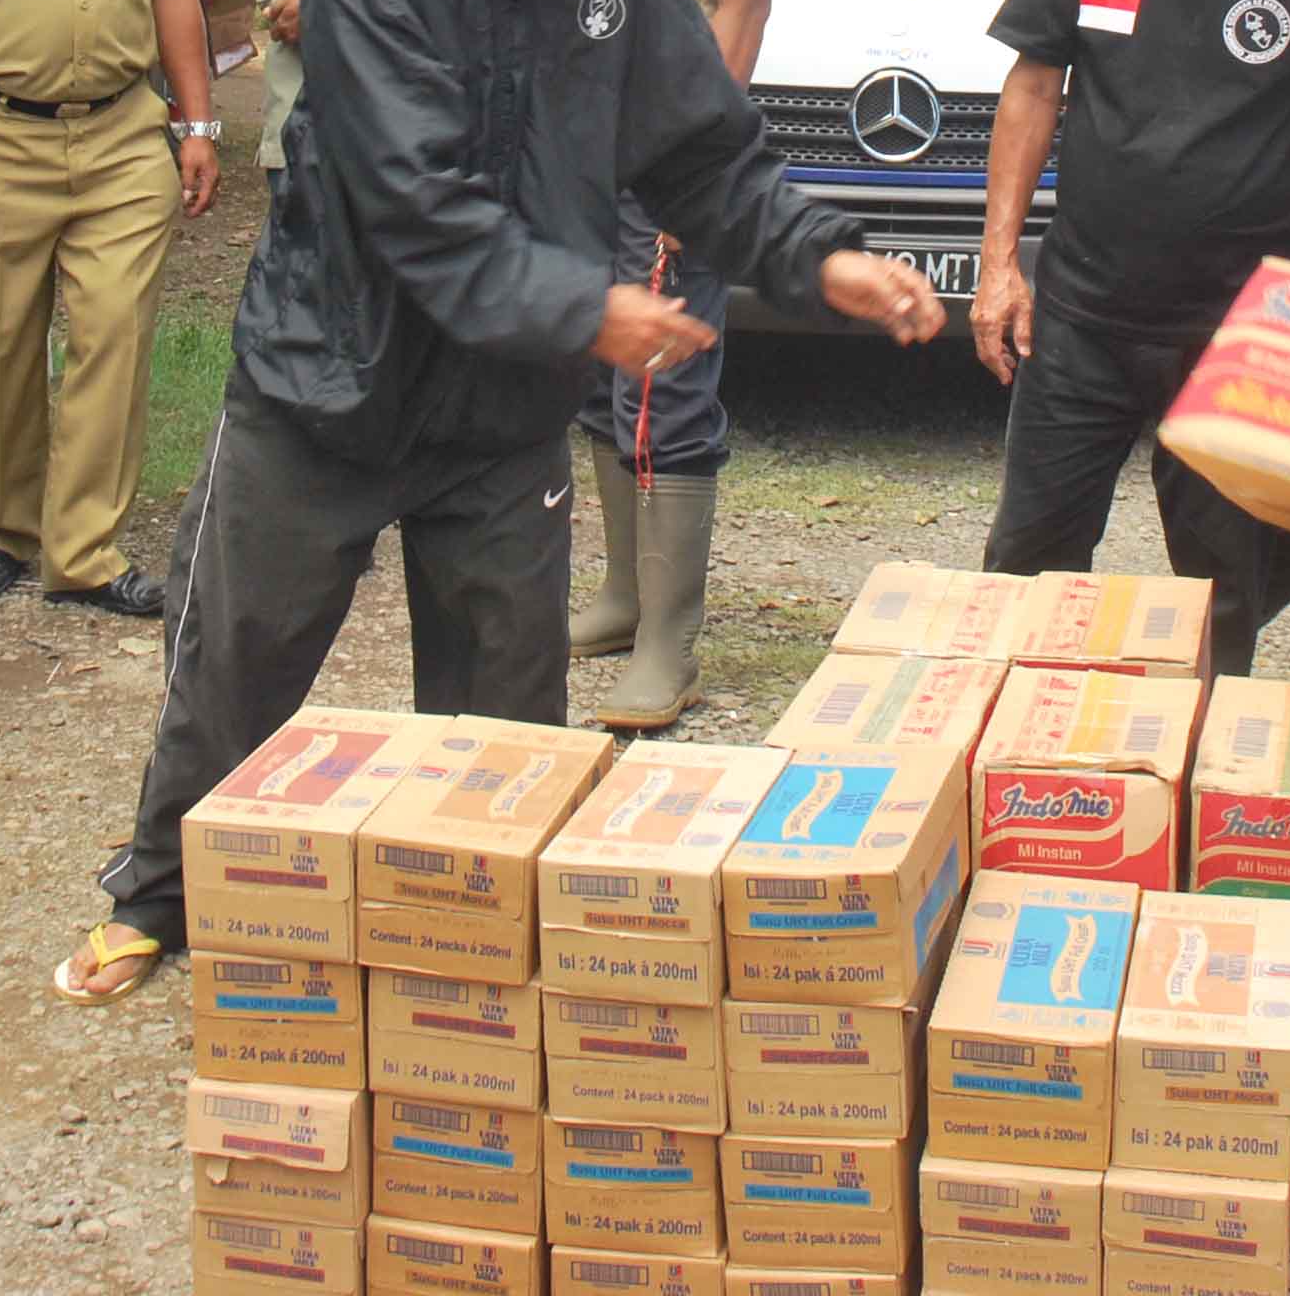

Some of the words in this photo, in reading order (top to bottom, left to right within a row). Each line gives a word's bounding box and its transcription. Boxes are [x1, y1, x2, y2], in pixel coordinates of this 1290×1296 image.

[1017, 843, 1035, 857] Mi
[1037, 844, 1082, 860] Instan
[227, 919, 244, 933] 24
[247, 922, 272, 939] pak
[288, 927, 331, 944] 200ml
[420, 935, 434, 949] 24
[588, 956, 607, 972] 24
[610, 957, 637, 978] pak
[653, 964, 699, 982] 200ml
[772, 964, 791, 981] 24
[794, 964, 822, 984] pak
[838, 965, 885, 983] 200ml
[239, 1045, 257, 1061] 24
[260, 1046, 286, 1065] pak
[301, 1049, 345, 1066] 200ml
[411, 1062, 429, 1078] 24
[431, 1066, 457, 1084] pak
[473, 1074, 516, 1093] 200ml
[624, 1087, 637, 1100] 24
[777, 1101, 796, 1116] 24
[799, 1103, 826, 1121] pak
[843, 1104, 888, 1120] 200ml
[998, 1124, 1012, 1138] 24
[1164, 1130, 1182, 1147] 24
[1185, 1132, 1214, 1153] pak
[1232, 1137, 1278, 1155] 200ml
[436, 1183, 449, 1197] 24
[593, 1214, 610, 1229] 24
[614, 1216, 641, 1235] pak
[658, 1218, 702, 1235] 200ml
[794, 1231, 809, 1245] 24
[998, 1266, 1013, 1281] 24
